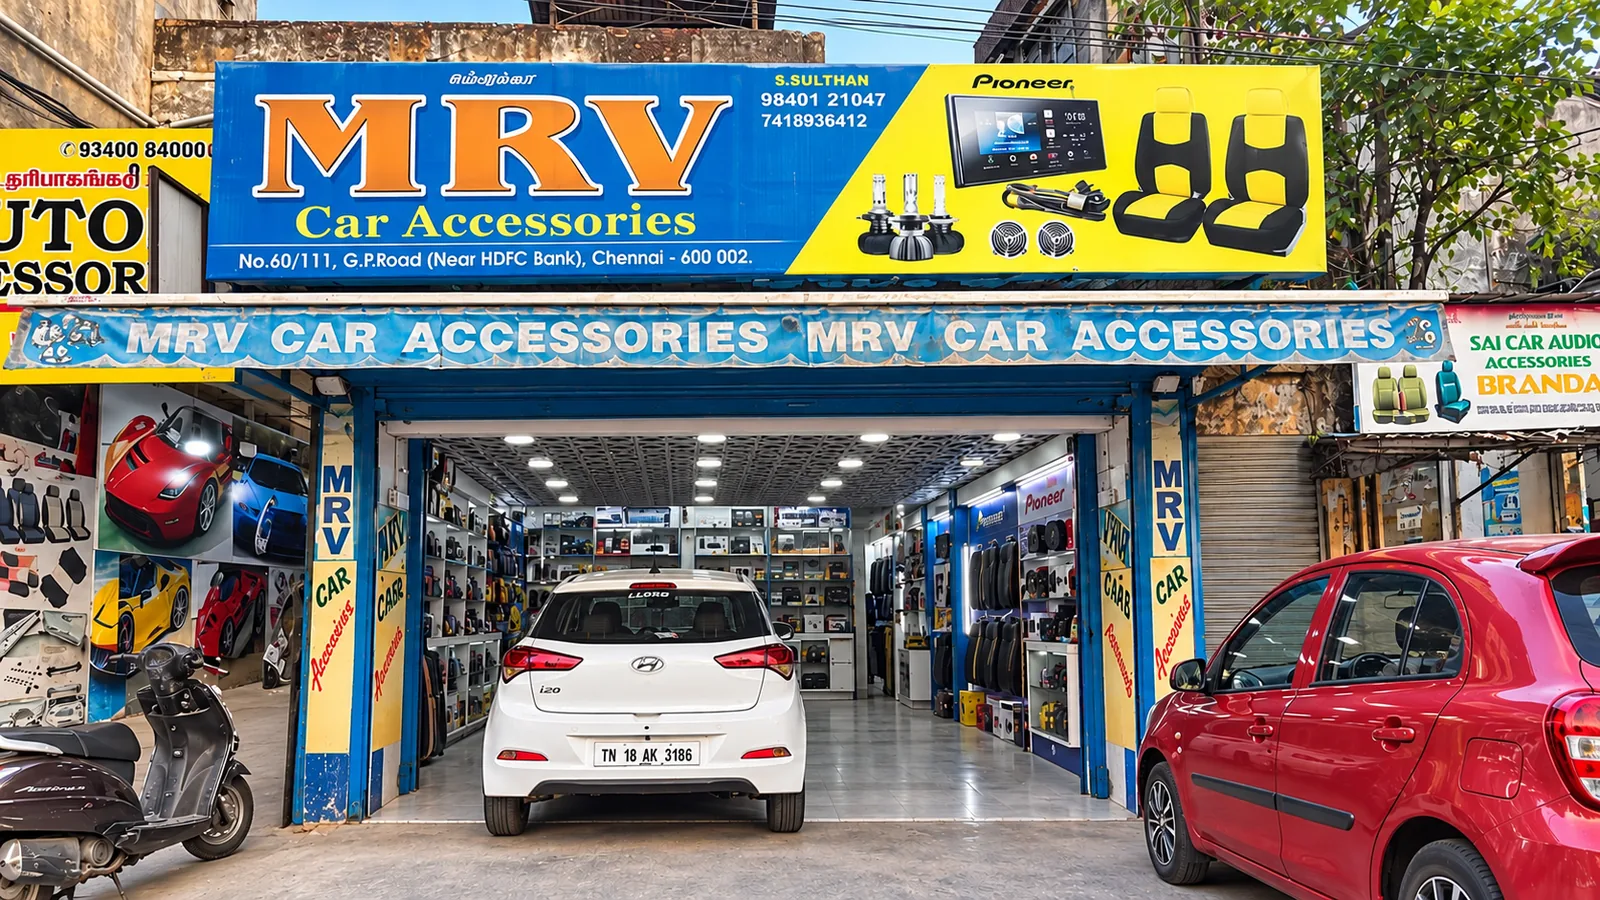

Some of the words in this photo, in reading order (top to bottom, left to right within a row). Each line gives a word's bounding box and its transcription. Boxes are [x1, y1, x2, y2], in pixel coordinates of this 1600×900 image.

[775, 74, 869, 86] S.SULTHAN
[972, 74, 1073, 89] Pioneer
[760, 92, 819, 107] 98401
[827, 92, 886, 107] 21047
[761, 113, 867, 128] 7418936412
[79, 141, 138, 158] 93400
[252, 94, 733, 198] MRV
[295, 205, 389, 238] Car
[401, 202, 696, 238] Accessories
[239, 252, 337, 270] No.60/111,
[343, 252, 421, 267] G.P.Road
[427, 252, 476, 270] (Near
[481, 251, 528, 266] HDFC
[533, 250, 586, 269] Bank),
[592, 249, 664, 265] Chennai
[680, 249, 712, 264] 600
[716, 249, 753, 264] 002.
[126, 322, 249, 354] MRV
[271, 322, 377, 354] CAR
[401, 321, 769, 353] ACCESSORIES
[807, 321, 917, 352] MRV
[944, 320, 1048, 351] CAR
[1072, 318, 1396, 351] ACCESSORIES
[1469, 335, 1502, 351] SAI
[1505, 334, 1545, 350] CAR
[1548, 333, 1600, 350] AUDIO
[1485, 355, 1592, 369] ACCESSORIES
[322, 464, 353, 555] MRV
[1025, 488, 1065, 515] Pioneer
[1153, 459, 1185, 552] MRV
[315, 566, 352, 609] CAR
[1155, 564, 1189, 605] CAR
[539, 685, 561, 694] i20
[602, 748, 617, 762] TN
[624, 748, 637, 762] 18
[642, 748, 658, 762] AK
[664, 748, 693, 762] 3186
